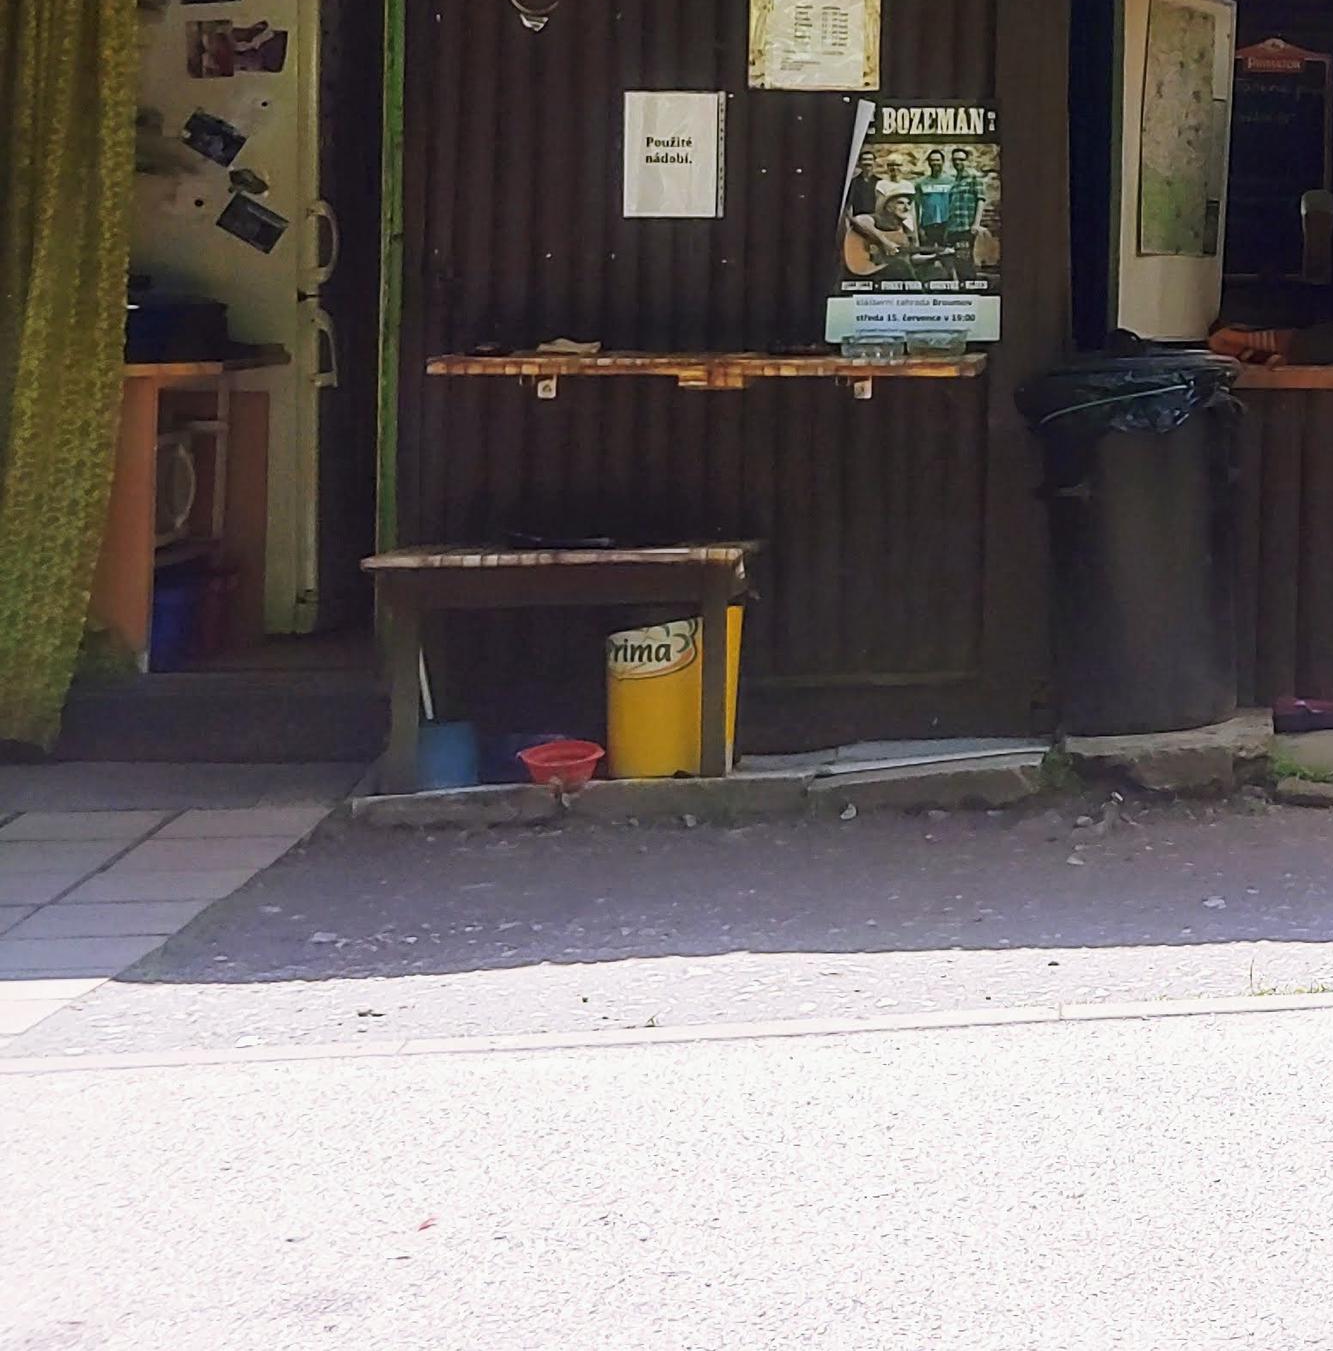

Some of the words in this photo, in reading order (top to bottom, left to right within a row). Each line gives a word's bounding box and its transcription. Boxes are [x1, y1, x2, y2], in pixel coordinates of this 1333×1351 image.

[882, 107, 985, 135] BOZEMAN
[646, 136, 692, 148] Použité
[645, 152, 692, 164] nádobí.
